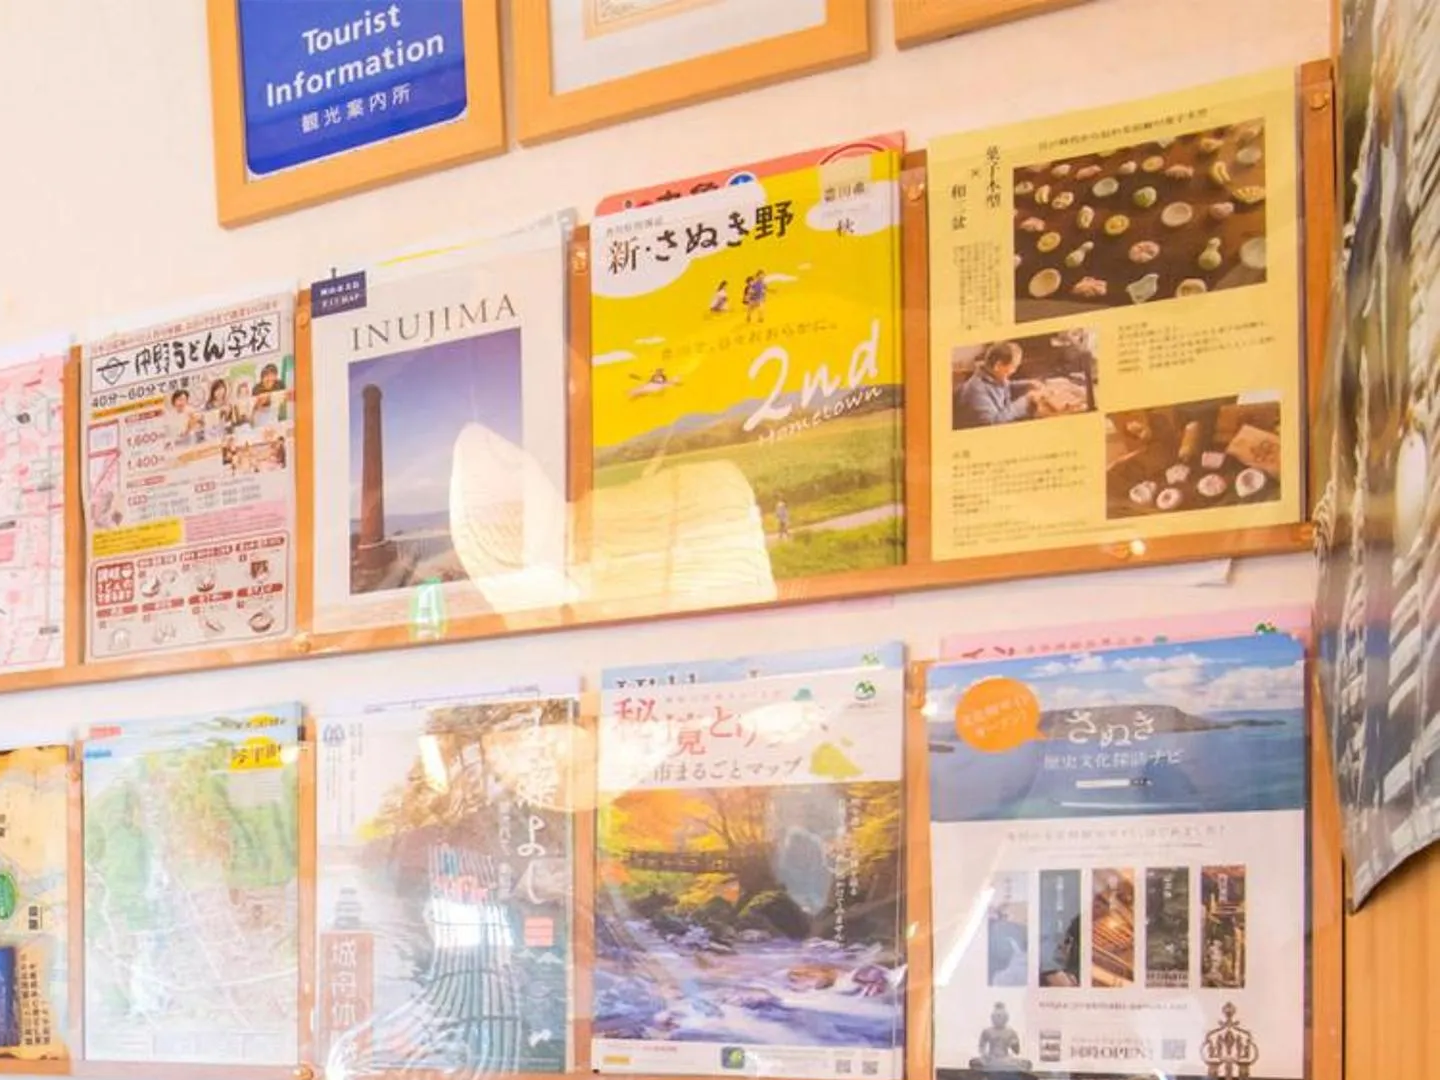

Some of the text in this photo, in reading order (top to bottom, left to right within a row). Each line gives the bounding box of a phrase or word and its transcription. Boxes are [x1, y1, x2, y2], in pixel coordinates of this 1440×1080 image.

[302, 4, 402, 56] Tourist
[266, 32, 445, 107] Information
[301, 84, 412, 133] 観光案内所
[608, 200, 794, 274] 新・さぬき野
[352, 293, 517, 351] INUJIMA
[743, 318, 881, 431] 2nd
[1064, 709, 1155, 747] さぬき
